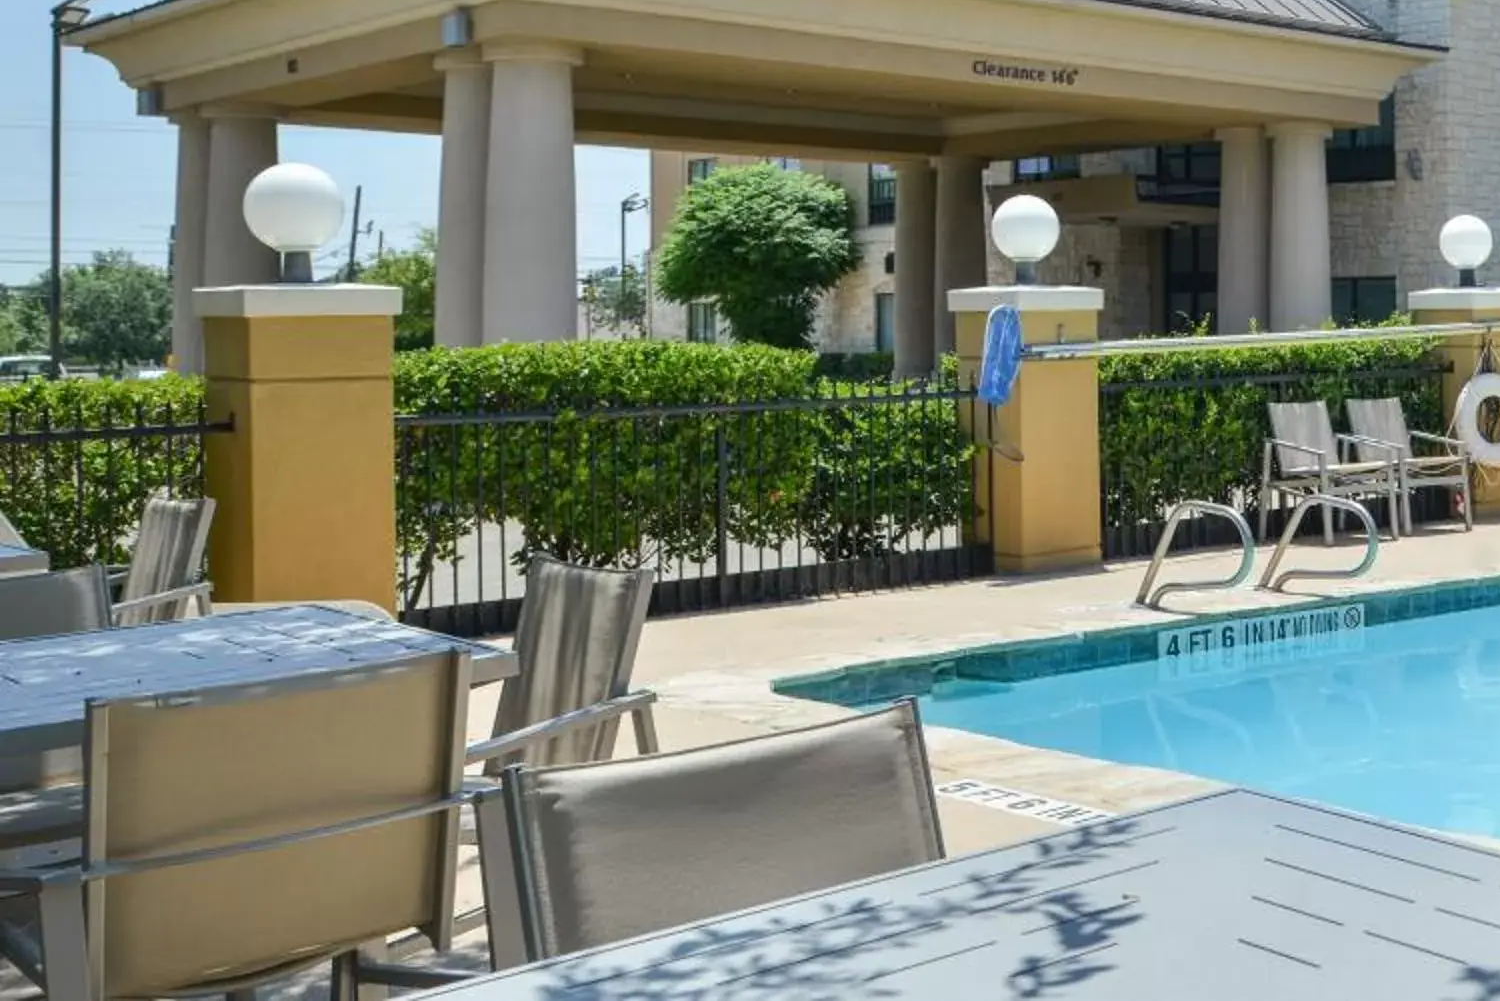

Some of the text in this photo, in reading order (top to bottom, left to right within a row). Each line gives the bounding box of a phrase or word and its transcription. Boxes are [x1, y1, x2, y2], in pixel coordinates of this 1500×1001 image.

[973, 61, 1045, 81] Clearance
[1167, 634, 1180, 656] 4
[1190, 629, 1212, 654] FT
[1222, 625, 1235, 648] 6
[1245, 620, 1264, 646] IN
[939, 782, 979, 794] 5
[962, 788, 1020, 803] FT
[1008, 798, 1047, 810] 6
[1035, 805, 1092, 820] IN
